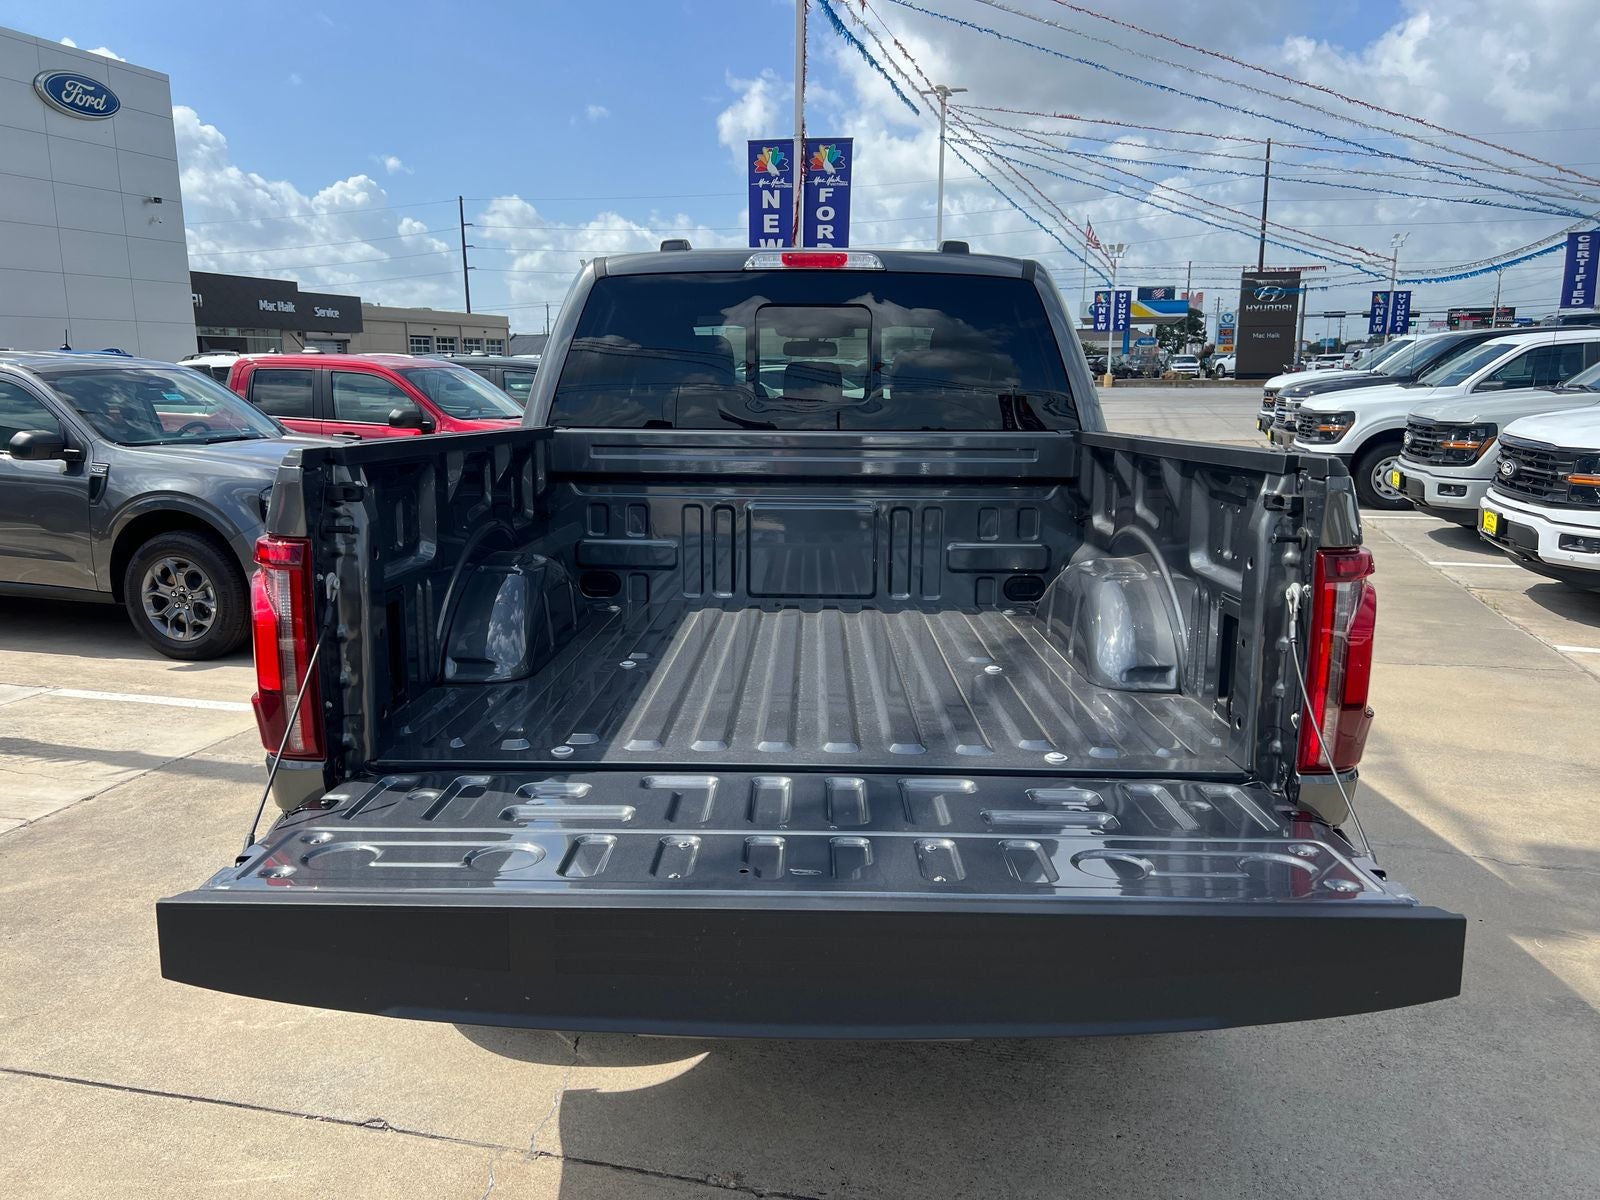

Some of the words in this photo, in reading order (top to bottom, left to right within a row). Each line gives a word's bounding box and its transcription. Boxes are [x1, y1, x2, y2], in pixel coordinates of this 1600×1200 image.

[61, 80, 106, 111] Ford
[1571, 235, 1591, 305] CERTIFIED
[258, 300, 276, 312] Mac
[277, 301, 296, 313] Haik
[314, 306, 340, 318] Service
[1097, 307, 1107, 330] NEW
[1117, 293, 1127, 330] HYUNDAI
[1245, 304, 1293, 312] HYUNDAI
[1395, 293, 1406, 332] HYUNDAI
[1372, 307, 1384, 332] NEW
